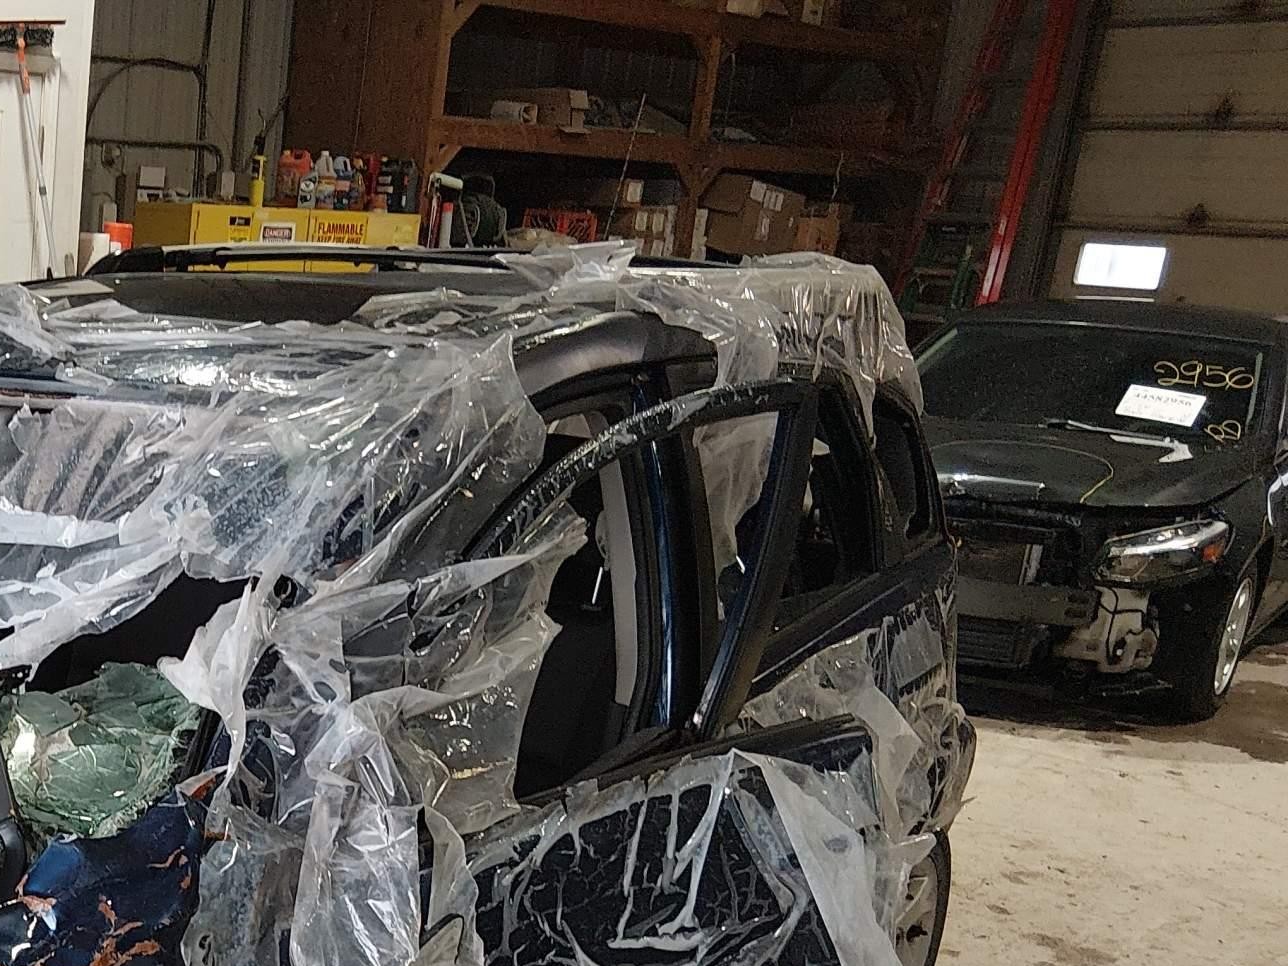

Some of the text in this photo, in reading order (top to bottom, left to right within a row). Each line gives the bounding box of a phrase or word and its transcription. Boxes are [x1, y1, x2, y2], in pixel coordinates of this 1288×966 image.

[264, 228, 292, 238] DANGER
[317, 222, 364, 236] FLAMMABLE
[1153, 360, 1255, 391] 2956
